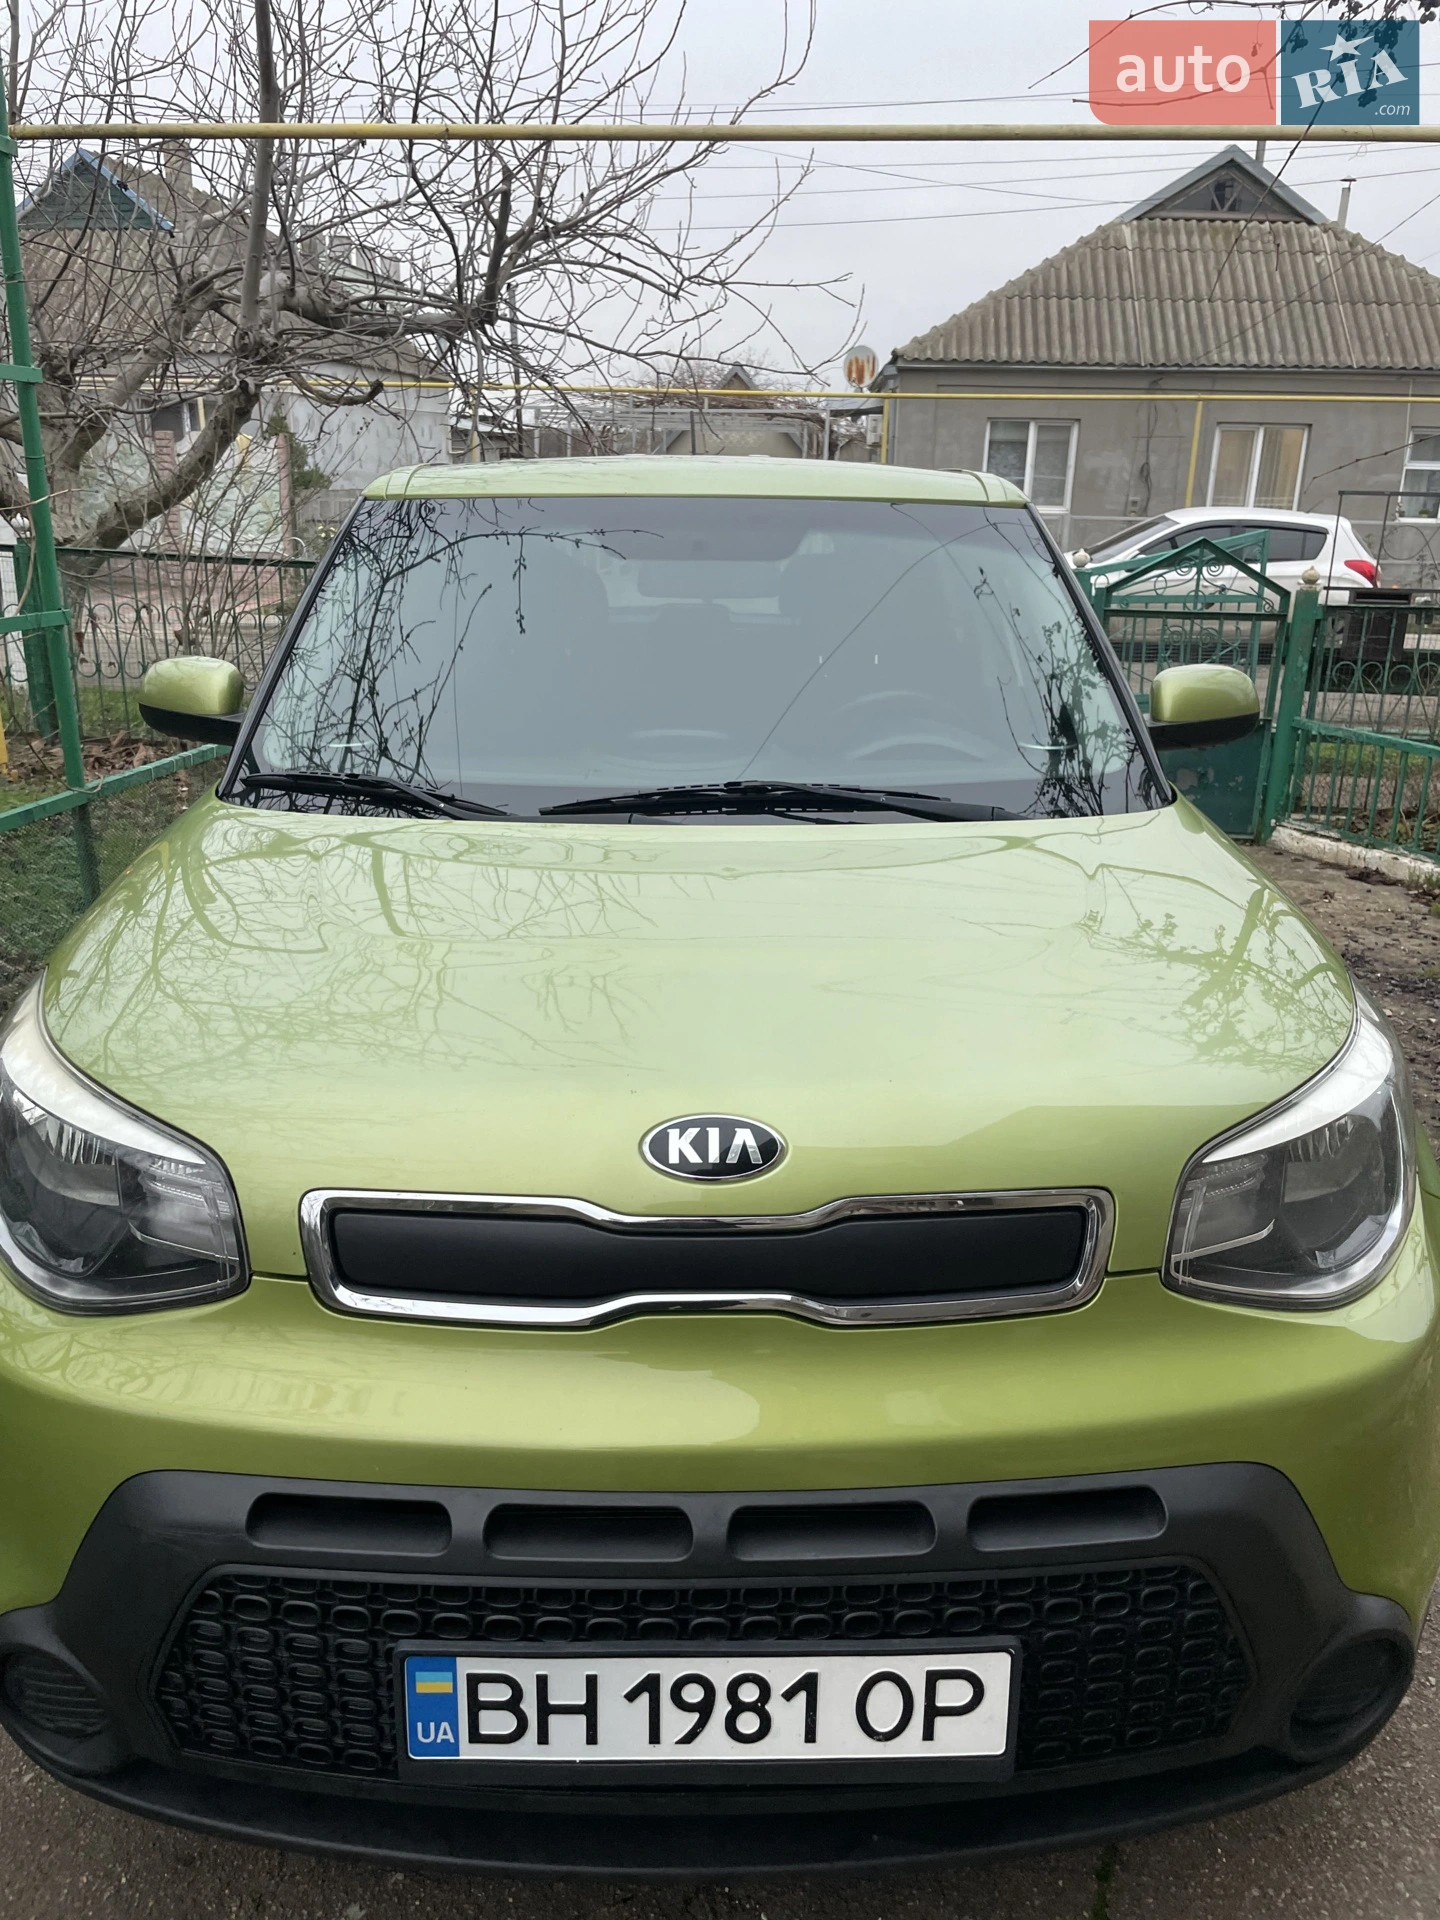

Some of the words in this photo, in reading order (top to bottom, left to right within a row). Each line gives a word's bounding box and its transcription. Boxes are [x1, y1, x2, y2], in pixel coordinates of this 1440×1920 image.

[666, 1127, 763, 1165] KIA
[466, 1672, 598, 1746] BH
[623, 1671, 818, 1746] 1981
[855, 1668, 985, 1742] OP
[417, 1721, 455, 1744] UA
